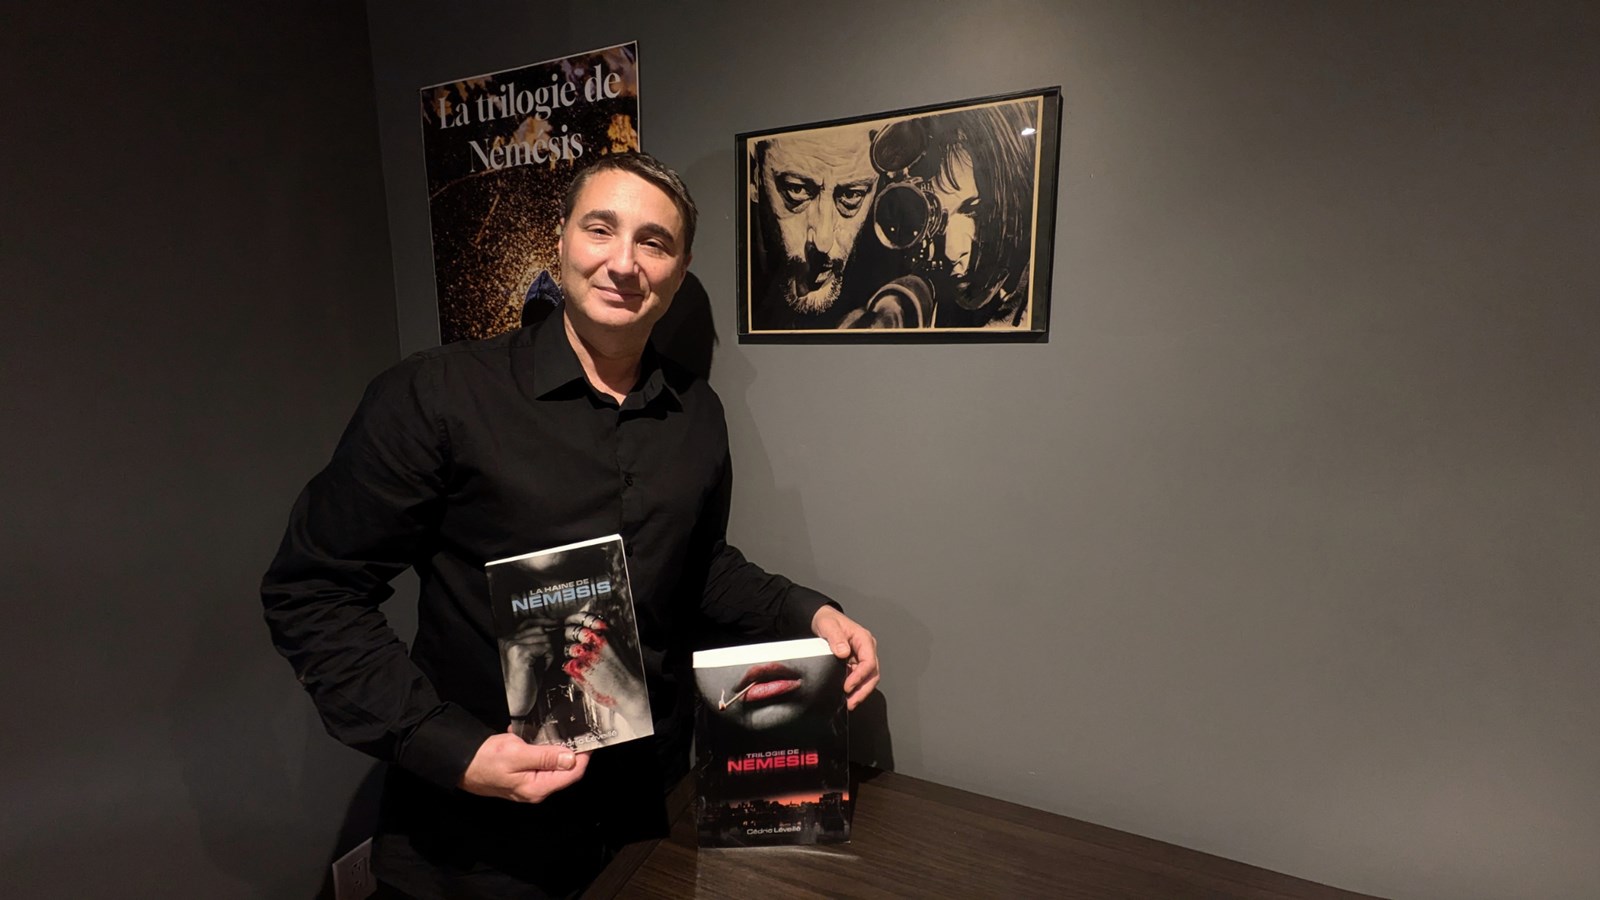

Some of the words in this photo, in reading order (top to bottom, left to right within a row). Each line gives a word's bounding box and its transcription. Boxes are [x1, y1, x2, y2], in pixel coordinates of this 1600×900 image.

[438, 96, 471, 130] La
[475, 73, 576, 121] trilogie
[584, 63, 621, 103] de
[544, 581, 575, 593] HAINE
[576, 578, 589, 586] DE
[746, 750, 786, 758] TRILOGIE
[727, 753, 819, 773] NEMESIS
